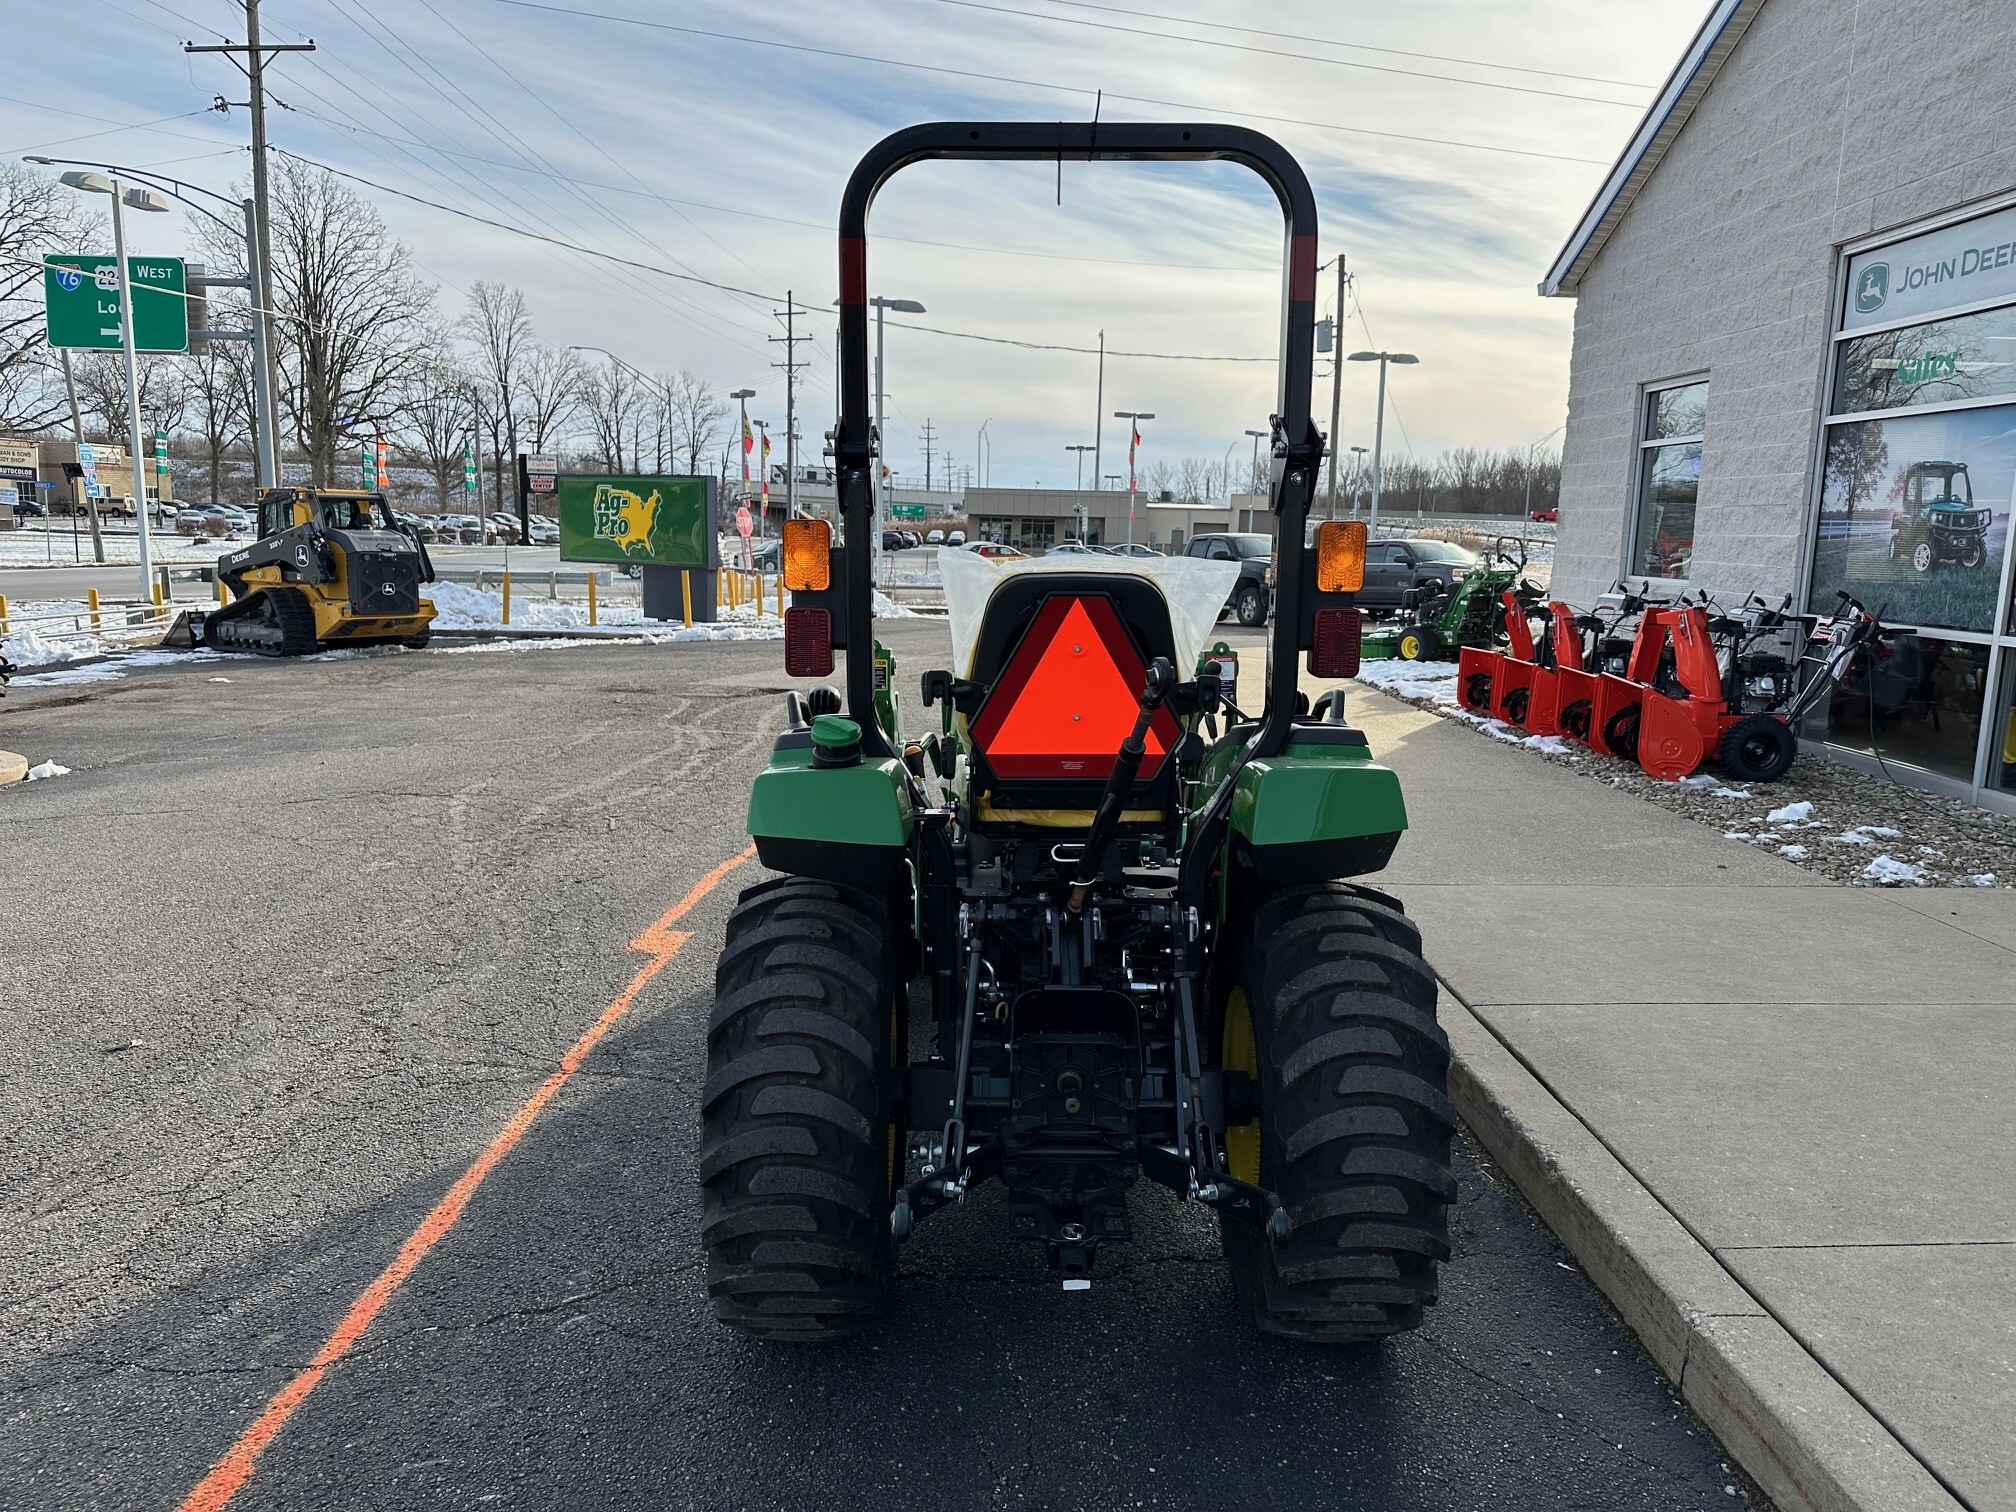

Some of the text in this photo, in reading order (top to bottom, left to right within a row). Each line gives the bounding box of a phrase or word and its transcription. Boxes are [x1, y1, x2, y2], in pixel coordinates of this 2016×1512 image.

[59, 265, 173, 286] 76 22 WEST
[1896, 258, 1956, 293] JOHN
[85, 473, 96, 484] 76
[595, 486, 629, 518] Ag-
[596, 511, 630, 537] Pro
[231, 550, 250, 564] DEERE
